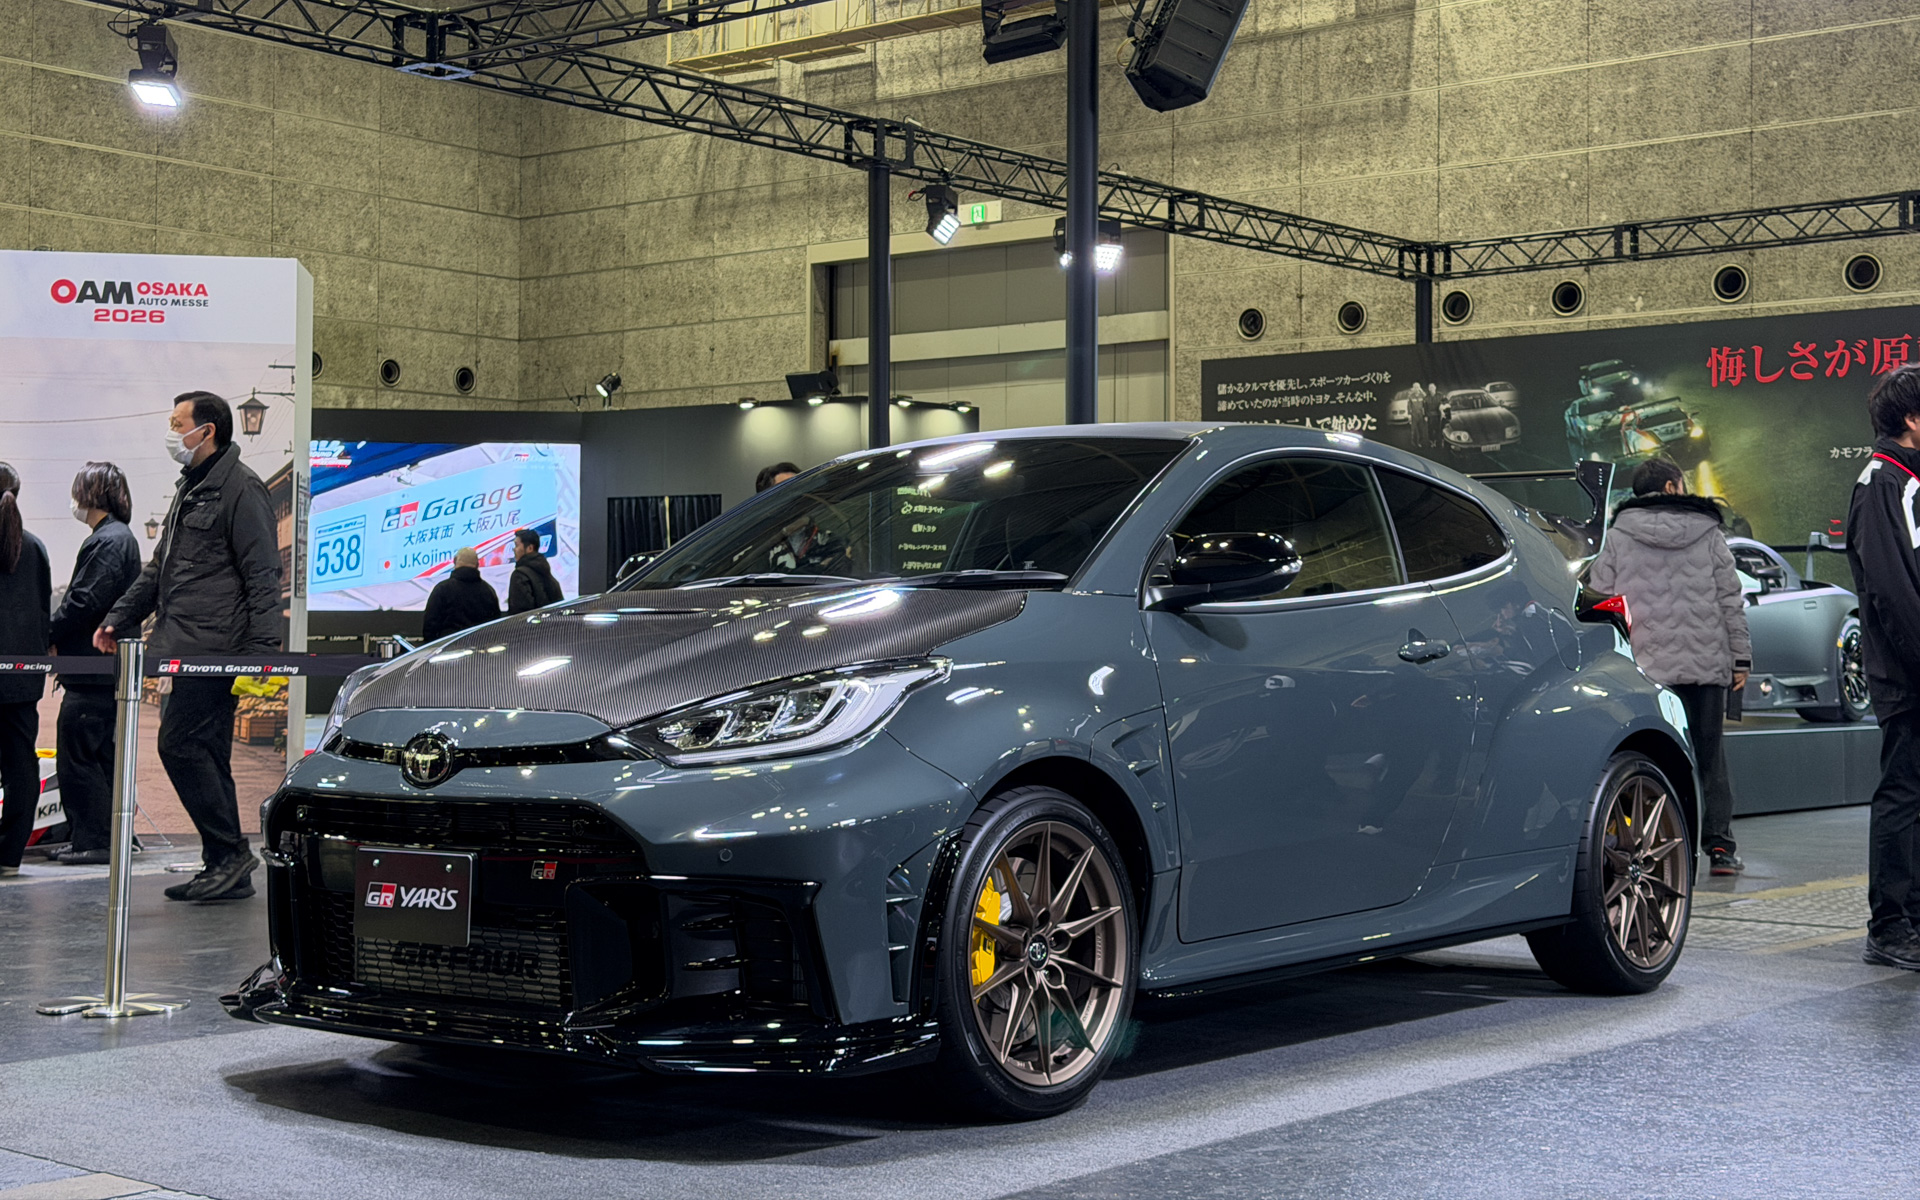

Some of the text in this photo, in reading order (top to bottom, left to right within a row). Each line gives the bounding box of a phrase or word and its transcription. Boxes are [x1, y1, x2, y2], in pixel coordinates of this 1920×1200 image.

[50, 278, 209, 305] OAM OSAKA
[138, 297, 209, 308] AUTO MESSE
[93, 308, 166, 324] 2026
[1706, 333, 1920, 388] 悔しさが原
[382, 509, 418, 533] GR
[421, 483, 524, 522] Garage
[403, 509, 521, 548] 大阪箕面 大阪八尾
[316, 534, 361, 576] 538
[400, 549, 457, 569] J.Kojim
[15, 662, 52, 672] Racing
[182, 664, 223, 673] TOYOTA
[225, 664, 262, 673] GAZOO
[263, 665, 299, 675] Racing
